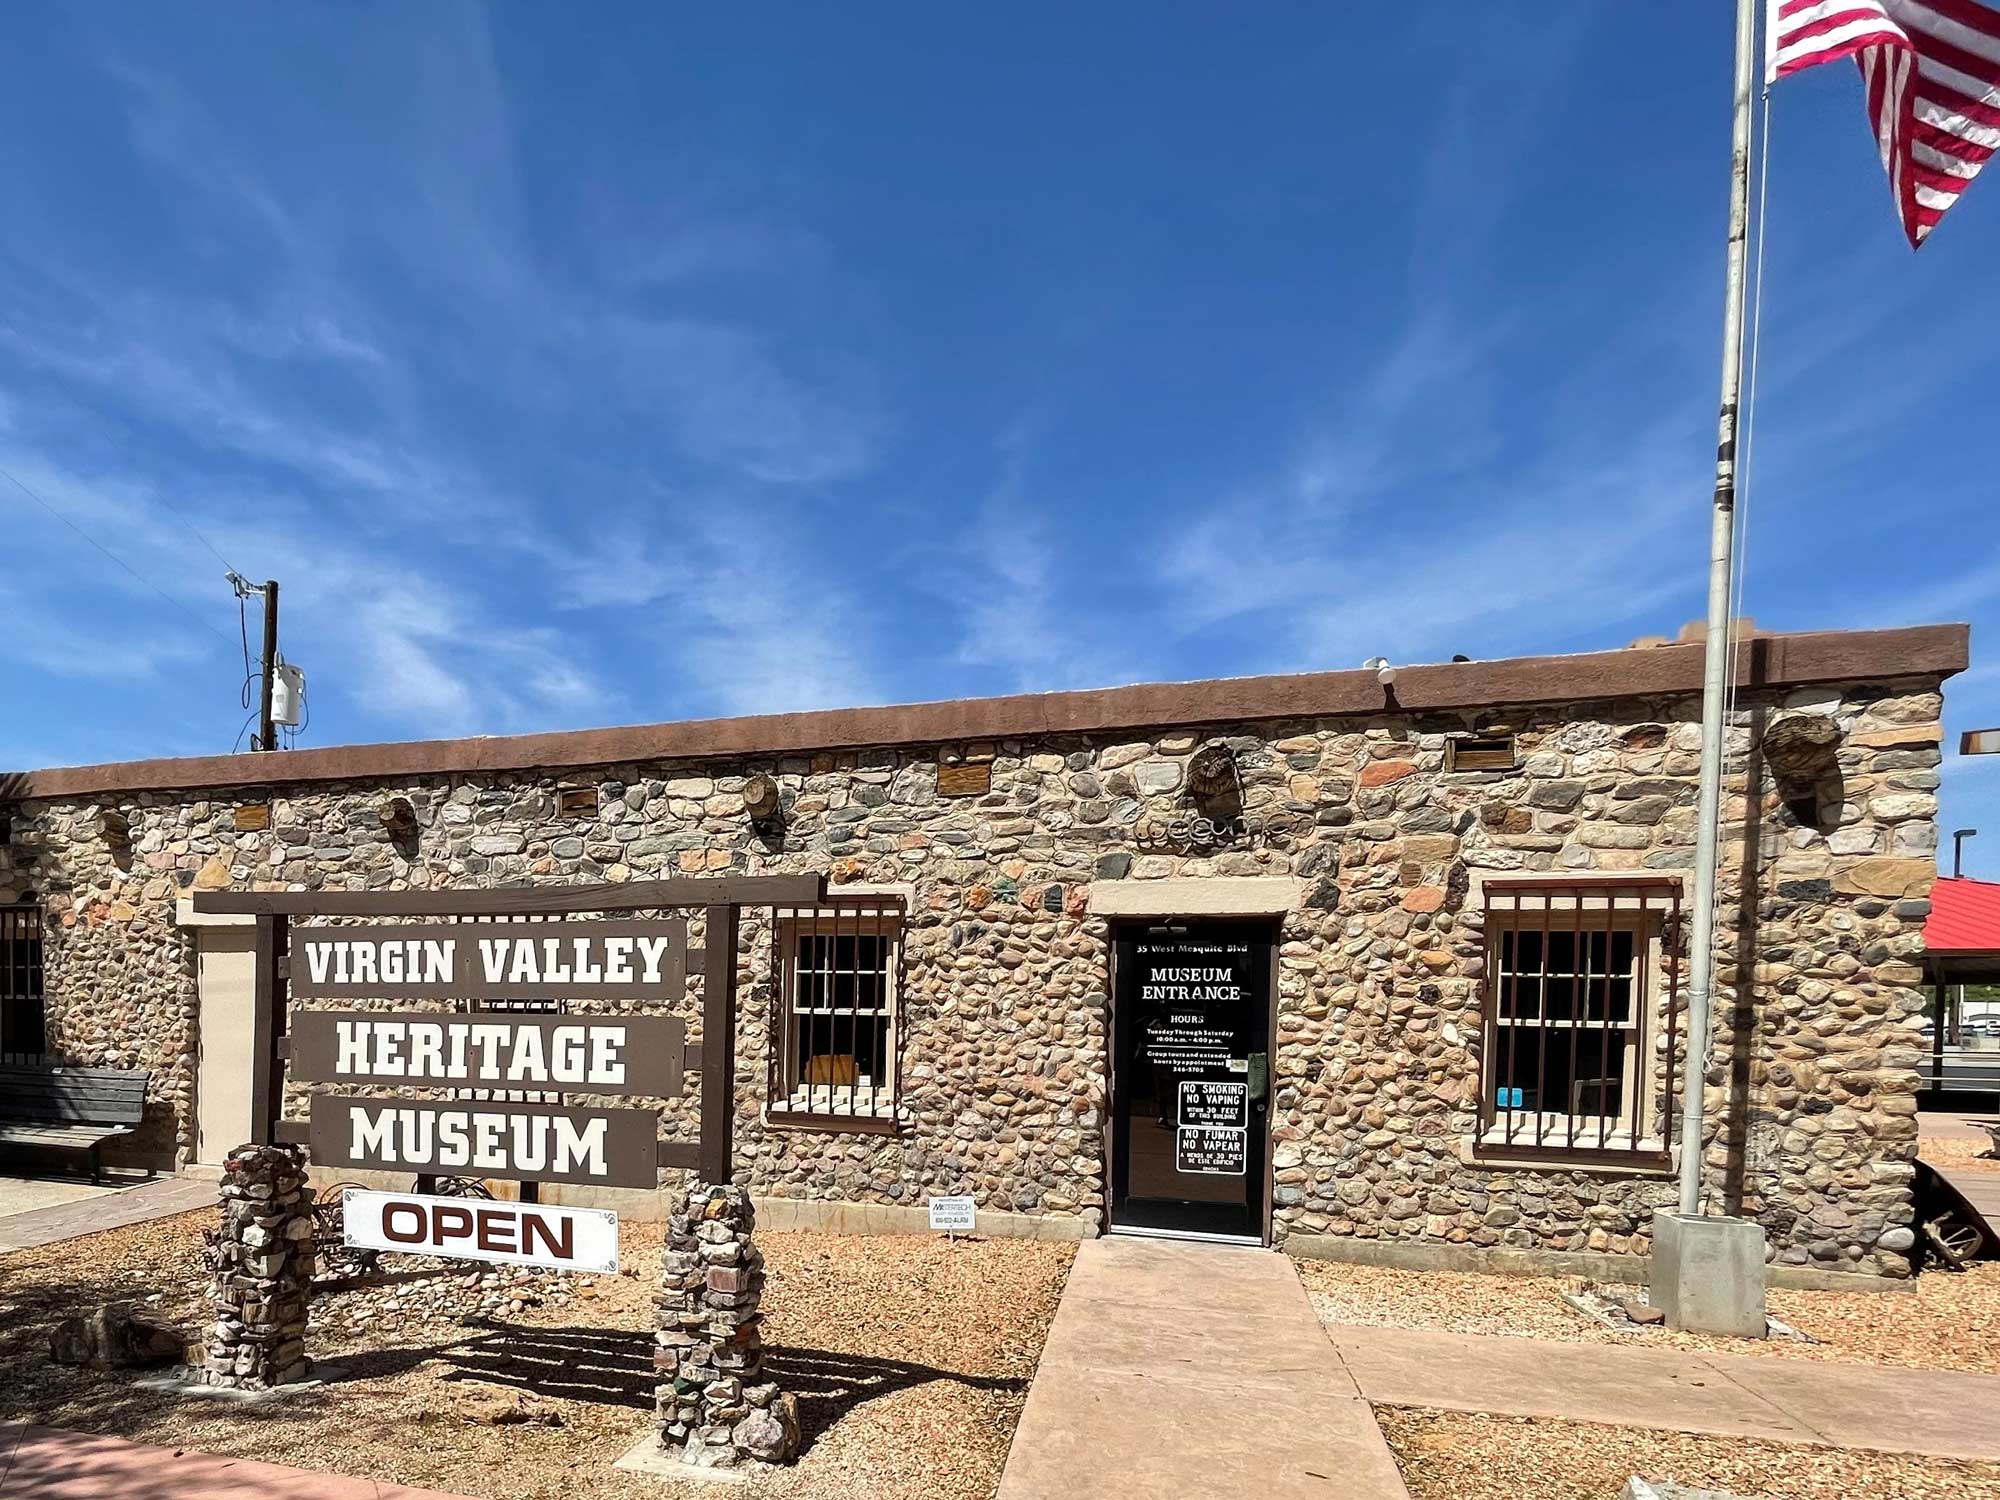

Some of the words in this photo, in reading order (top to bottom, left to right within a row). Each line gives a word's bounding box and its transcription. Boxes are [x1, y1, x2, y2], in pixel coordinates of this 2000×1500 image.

[1137, 945, 1147, 953] 35
[1151, 945, 1175, 953] West
[1179, 945, 1223, 954] Mesquite
[1227, 944, 1248, 953] Blvd
[305, 940, 455, 984] VIRGIN
[478, 937, 668, 984] VALLEY
[1151, 968, 1232, 982] MUSEUM
[1142, 986, 1240, 1000] ENTRANCE
[1170, 1015, 1204, 1023] HOURS
[336, 1021, 626, 1085] HERITAGE
[1183, 1085, 1196, 1093] NO
[1202, 1085, 1244, 1095] SMOKING
[1187, 1095, 1199, 1103] NO
[1206, 1095, 1239, 1105] VAPING
[349, 1107, 608, 1176] MUSEUM
[1185, 1130, 1199, 1139] NO
[1205, 1131, 1238, 1141] FUMAR
[1182, 1140, 1196, 1149] NO
[1203, 1140, 1240, 1151] VAPEAR
[382, 1202, 574, 1259] OPEN
